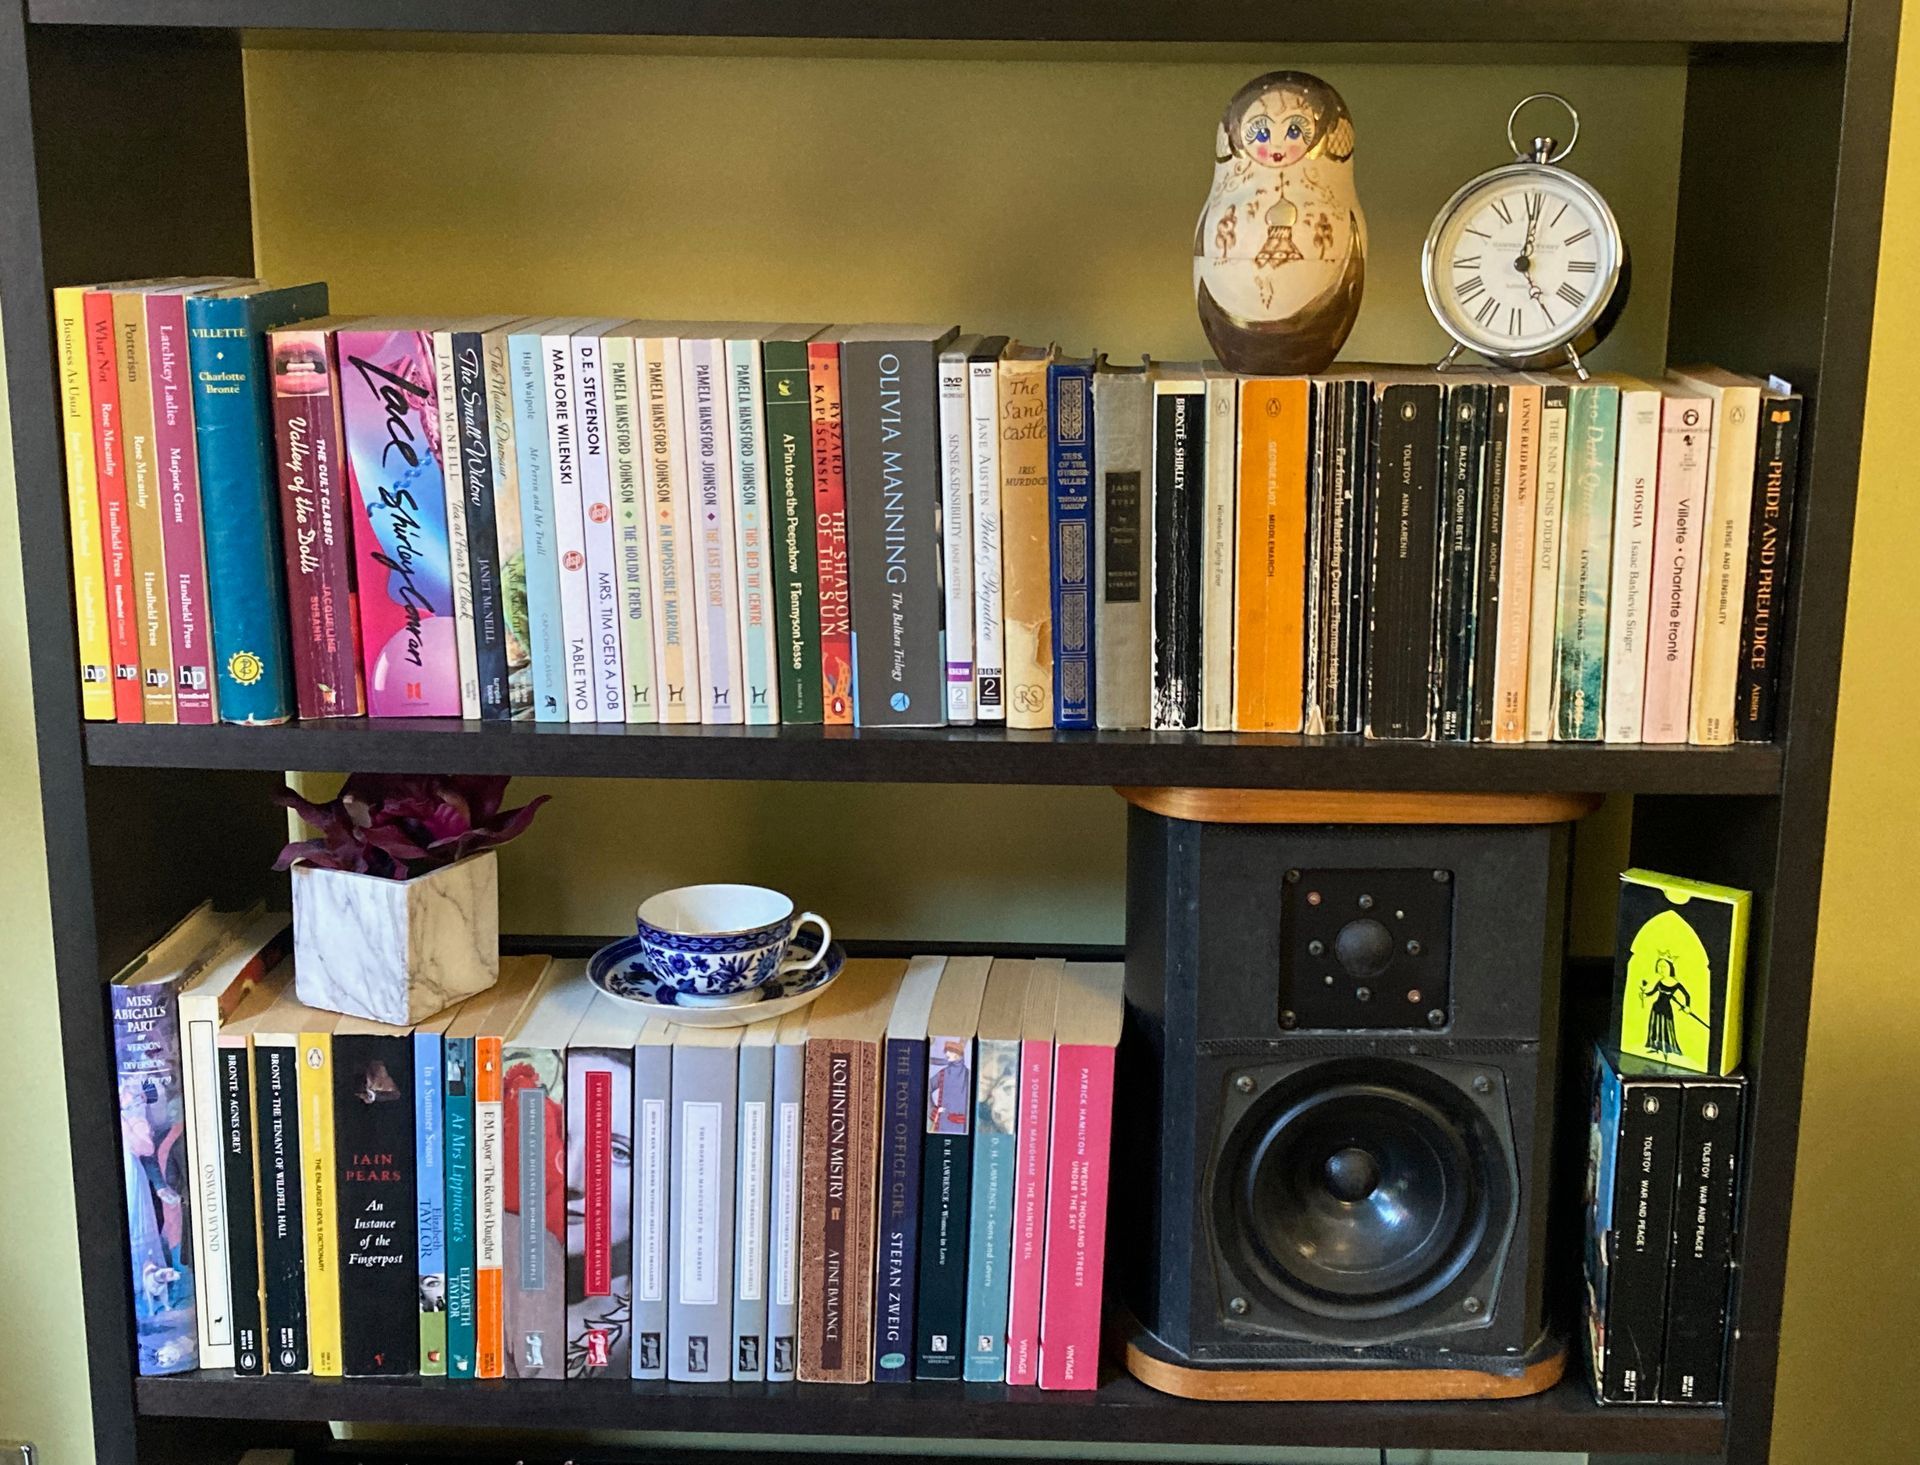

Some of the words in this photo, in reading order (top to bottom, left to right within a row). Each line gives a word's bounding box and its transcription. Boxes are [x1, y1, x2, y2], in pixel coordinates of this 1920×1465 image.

[63, 318, 74, 365] Business
[95, 320, 108, 355] What
[192, 329, 247, 338] VILLETTE
[125, 323, 138, 382] Potterism
[160, 325, 175, 382] Latchkey
[459, 349, 477, 385] The
[581, 348, 593, 373] D.E.
[65, 369, 78, 383] As
[98, 360, 110, 382] Not
[198, 372, 246, 381] Charlotte
[552, 349, 568, 420] MARJORIE
[612, 363, 625, 400] PAMELA
[1010, 382, 1040, 395] The
[68, 387, 80, 417] Usual
[165, 385, 178, 426] Ladies
[348, 355, 430, 468] Lace
[461, 388, 481, 439] Small
[584, 377, 600, 456] STEVENSON
[878, 354, 902, 443] OLIVIA
[286, 417, 307, 472] Valley
[615, 404, 630, 455] HANSFORD
[830, 403, 841, 475] RYSZARD
[975, 417, 990, 449] JANE
[1003, 428, 1047, 440] castle
[1549, 417, 1559, 444] THE
[168, 448, 182, 490] Marjorie
[557, 424, 572, 485] WILENSKI
[1019, 465, 1036, 475] IRIS
[1174, 448, 1184, 490] SHIRLEY
[1402, 444, 1412, 485] TOLSTOY
[1547, 447, 1558, 474] NUN
[288, 476, 312, 493] of
[465, 441, 487, 506] Widow
[619, 458, 634, 503] JOHNSON
[979, 455, 991, 506] AUSTEN
[1765, 461, 1783, 518] PRIDE
[173, 493, 185, 522] Grant
[296, 497, 313, 523] the
[1401, 493, 1409, 517] ANNA
[1545, 482, 1556, 516] DENIS
[1633, 478, 1645, 528] SHOSHA
[371, 487, 423, 576] Shirley
[623, 525, 636, 543] THE
[818, 513, 831, 540] OF
[831, 509, 844, 543] THE
[883, 452, 907, 585] MANNING
[980, 512, 997, 554] Pride
[297, 529, 319, 574] Dolls
[1267, 514, 1276, 577] MIDDLEMARCH
[1400, 520, 1408, 558] KARENIN
[1542, 519, 1553, 570] DIDEROT
[1630, 541, 1641, 568] Isaac
[1761, 523, 1776, 564] AND
[625, 546, 639, 582] HOLIDAY
[820, 547, 833, 584] THE
[179, 574, 192, 622] Handheld
[598, 572, 611, 604] MRS.
[627, 587, 642, 620] FRIEND
[834, 552, 848, 635] SHADOW
[892, 593, 903, 611] The
[1626, 571, 1638, 617] Bashevis
[601, 608, 613, 631] TIM
[820, 592, 835, 637] SUN
[980, 572, 1000, 641] Prejudice
[1751, 569, 1773, 670] PREJUDICE
[183, 624, 194, 649] Press
[399, 588, 435, 666] Conran
[893, 613, 904, 647] Balkan
[1624, 620, 1636, 652] Singer
[571, 638, 585, 676] TABLE
[603, 634, 616, 666] GETS
[893, 649, 905, 681] Trilogy
[605, 670, 617, 680] A
[575, 680, 588, 711] TWO
[606, 684, 619, 710] JOB
[1750, 683, 1761, 721] Austen
[113, 1009, 166, 1020] ABIGAIL'S
[126, 996, 152, 1007] MISS
[126, 1021, 155, 1033] PART
[424, 1066, 434, 1077] In
[897, 1047, 910, 1076] THE
[1032, 1064, 1039, 1073] W
[831, 1059, 846, 1144] ROHINTON
[895, 1081, 908, 1119] POST
[1029, 1078, 1039, 1125] SOMERSET
[1079, 1068, 1088, 1105] PATRICK
[424, 1089, 434, 1131] Summer
[482, 1135, 494, 1161] Mayor
[943, 1139, 952, 1148] D.
[1077, 1108, 1086, 1155] HAMILTON
[352, 1154, 393, 1165] IAIN
[425, 1134, 434, 1168] Season
[893, 1123, 908, 1178] OFFICE
[943, 1149, 951, 1158] H.
[1028, 1129, 1037, 1176] MAUGHAM
[1643, 1135, 1652, 1173] TOLSTOY
[1701, 1141, 1712, 1179] TOLSTOY
[345, 1170, 401, 1181] PEARS
[484, 1167, 494, 1183] The
[830, 1147, 844, 1201] MISTRY
[942, 1159, 951, 1203] LAWRENCE
[1027, 1182, 1035, 1200] THE
[1070, 1161, 1078, 1191] UNDER
[1080, 1161, 1089, 1197] TWENTY
[1640, 1180, 1649, 1199] WAR
[365, 1201, 384, 1211] An
[484, 1185, 496, 1219] Rector's
[891, 1183, 905, 1218] GIRL
[1070, 1194, 1078, 1211] THE
[1638, 1200, 1648, 1218] AND
[1698, 1185, 1708, 1204] WAR
[354, 1218, 396, 1229] Instance
[420, 1198, 432, 1259] TAYLOR
[432, 1207, 442, 1251] Elizabeth
[940, 1210, 949, 1237] Women
[1025, 1201, 1033, 1240] PAINTED
[1076, 1200, 1087, 1248] THOUSAND
[1697, 1206, 1706, 1223] AND
[360, 1238, 373, 1250] of
[375, 1237, 391, 1246] the
[483, 1219, 495, 1261] Daughter
[1024, 1241, 1032, 1259] VEIL
[1637, 1220, 1646, 1246] PEACE
[1695, 1225, 1704, 1249] PEACE
[349, 1253, 403, 1267] Fingerpost
[828, 1249, 839, 1258] A
[889, 1232, 903, 1287] STEFAN
[939, 1248, 947, 1265] Love
[1075, 1251, 1085, 1287] STREETS
[828, 1260, 839, 1287] FINE
[449, 1275, 460, 1318] TAYLOR
[459, 1267, 471, 1327] ELIZABETH
[826, 1288, 839, 1342] BALANCE
[887, 1292, 900, 1342] ZWEIG
[1018, 1339, 1028, 1375] VINTAGE
[1064, 1345, 1074, 1381] VINTAGE
